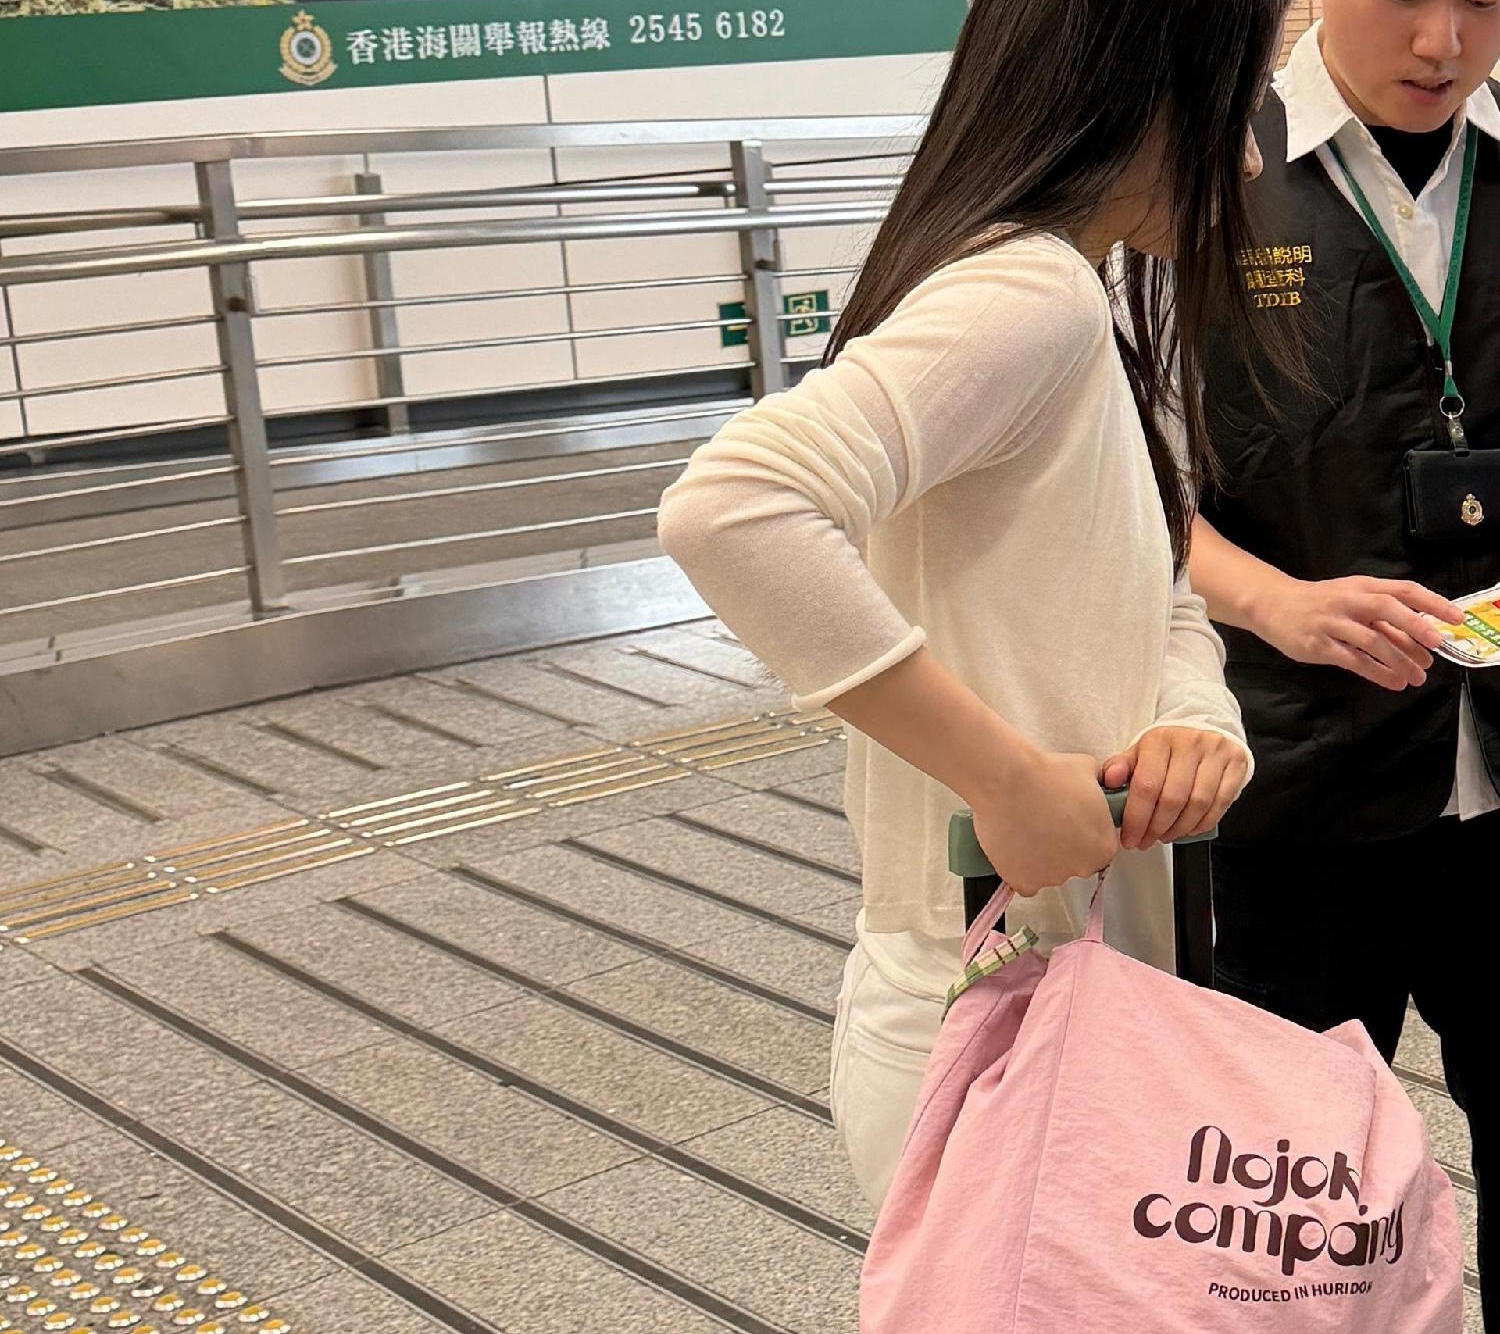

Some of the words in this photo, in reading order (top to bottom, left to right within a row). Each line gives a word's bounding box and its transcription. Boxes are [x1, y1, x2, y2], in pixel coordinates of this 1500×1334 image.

[346, 17, 611, 65] 香港海關舉報熱線
[629, 12, 702, 44] 2545
[715, 8, 786, 39] 6182
[1133, 1193, 1405, 1277] company
[1208, 1281, 1291, 1303] PRODUCED
[1294, 1283, 1310, 1301] IN
